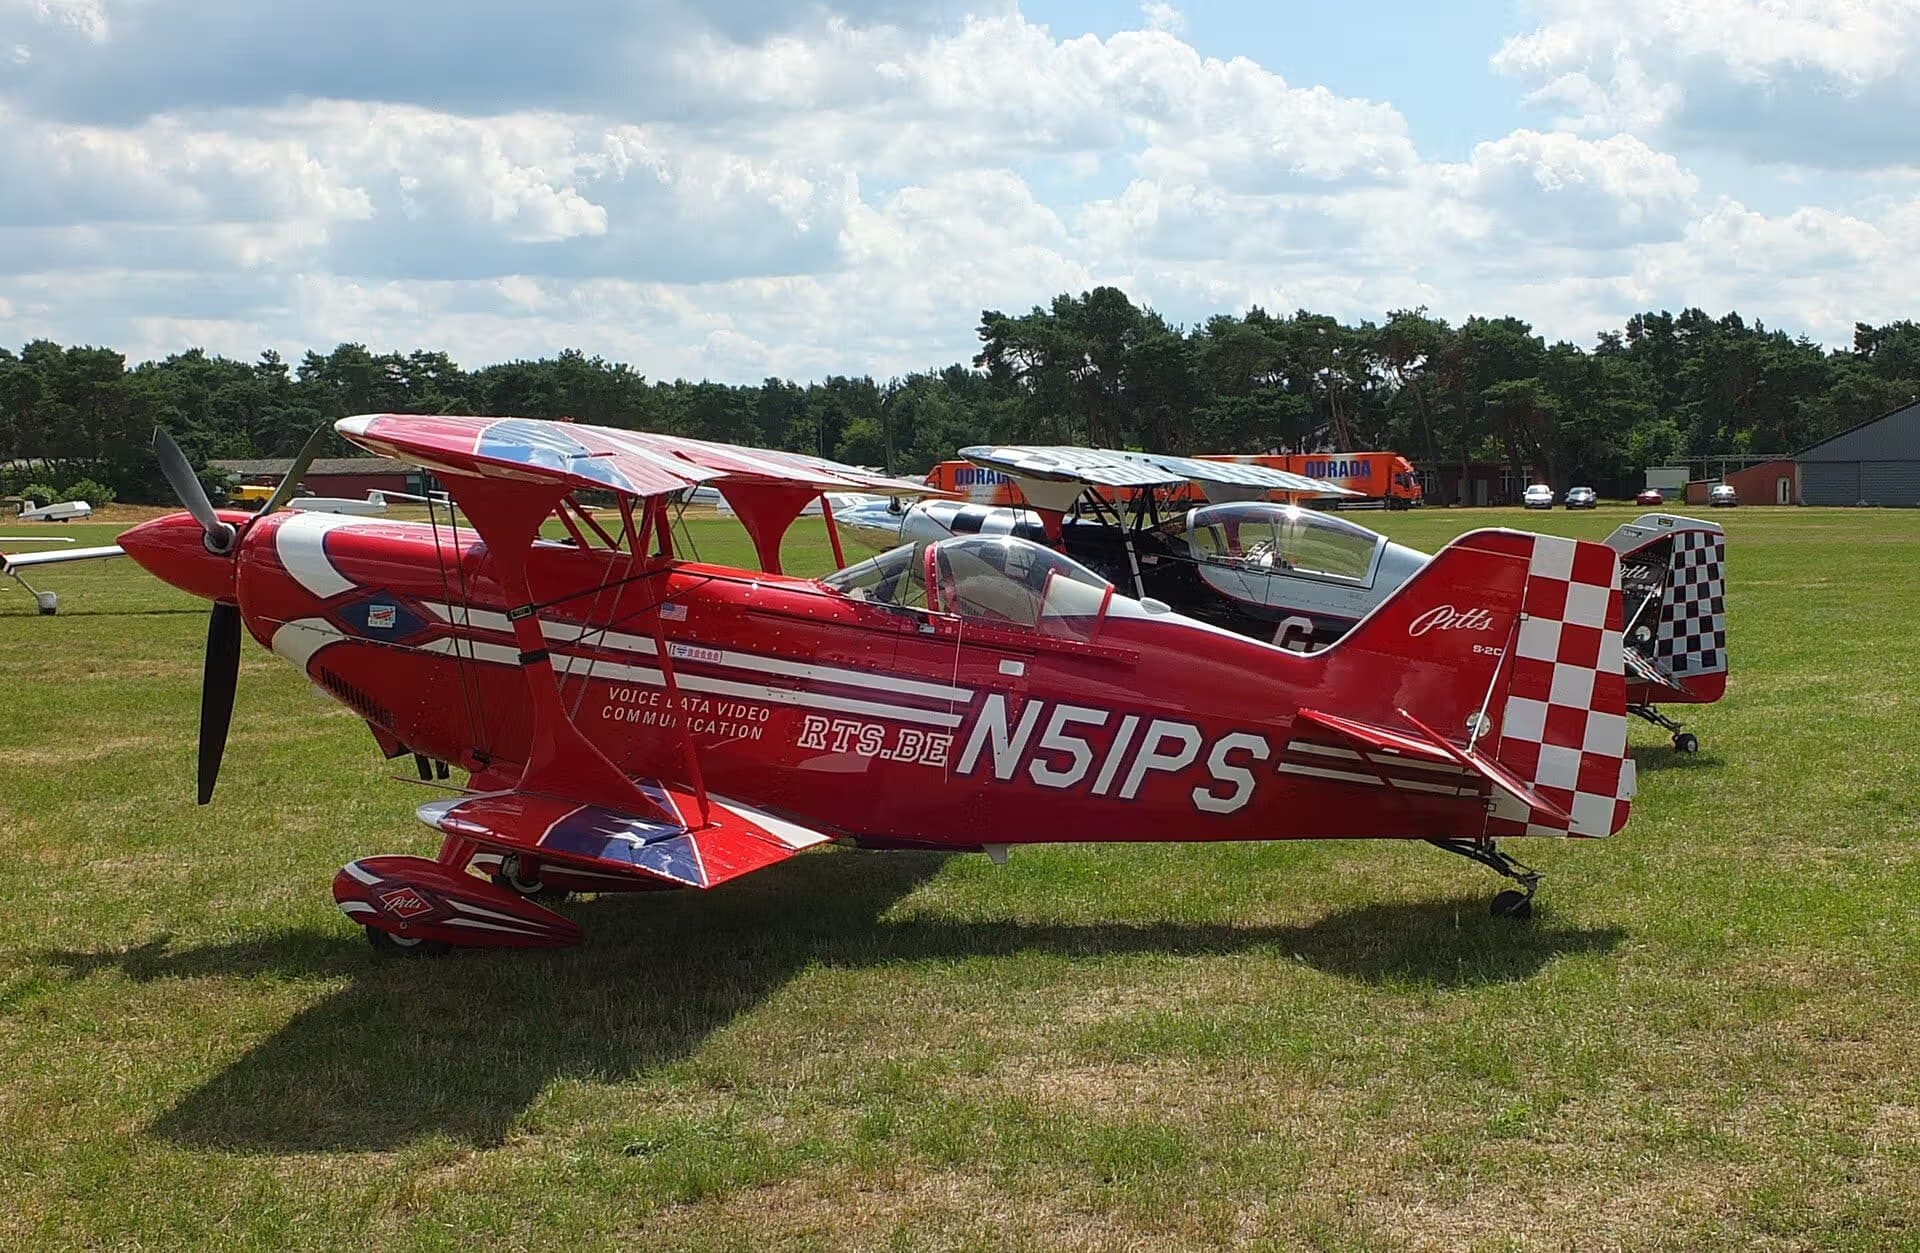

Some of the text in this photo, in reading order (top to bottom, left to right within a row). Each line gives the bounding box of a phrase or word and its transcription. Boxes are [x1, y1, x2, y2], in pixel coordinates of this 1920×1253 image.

[1408, 604, 1494, 637] Pitts
[609, 686, 661, 706] VOICE
[717, 702, 770, 722] VIDEO
[797, 714, 954, 767] RTS.BE
[955, 693, 1271, 814] N51PS
